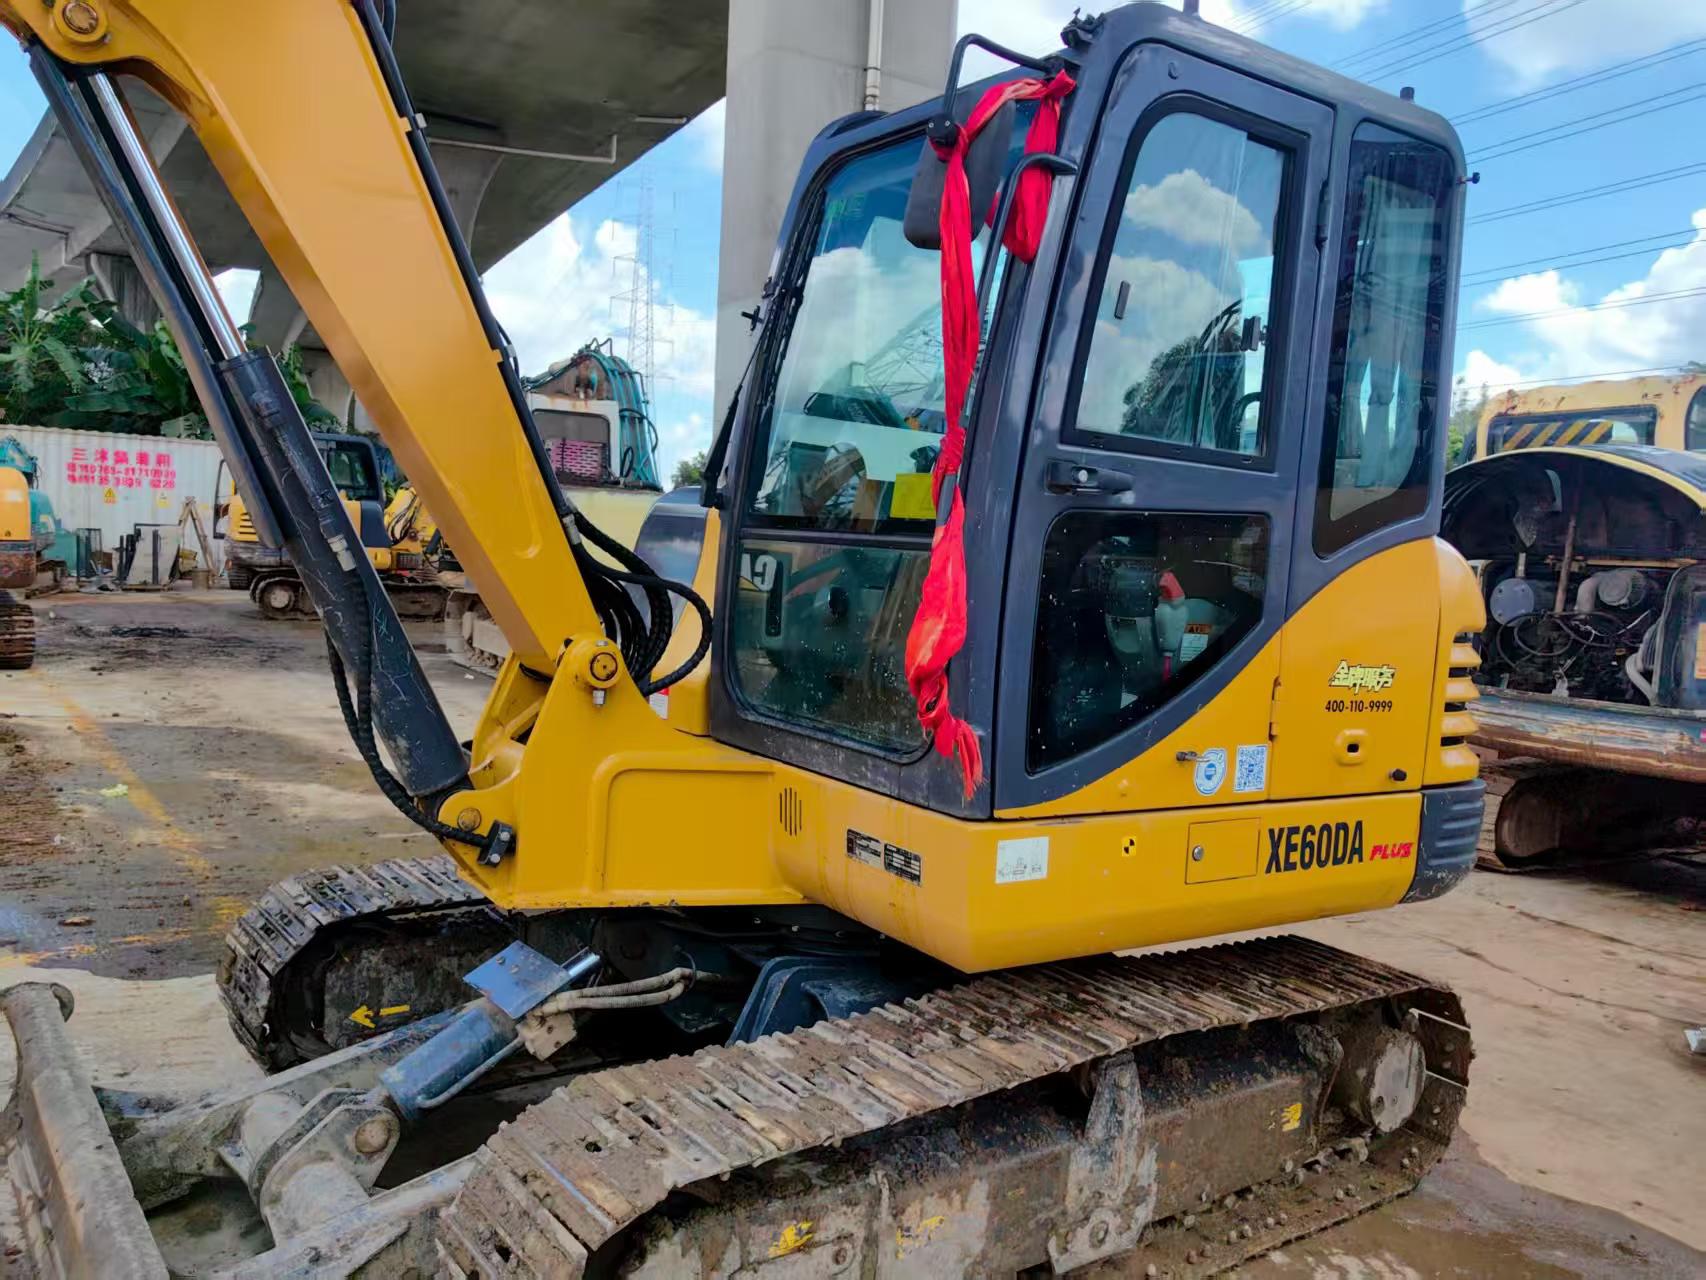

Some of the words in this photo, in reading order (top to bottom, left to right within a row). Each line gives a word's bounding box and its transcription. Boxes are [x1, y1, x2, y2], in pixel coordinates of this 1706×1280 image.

[1325, 700, 1393, 713] 400-110-9999
[1265, 820, 1364, 874] XE60DA
[1369, 842, 1414, 862] PLUS
